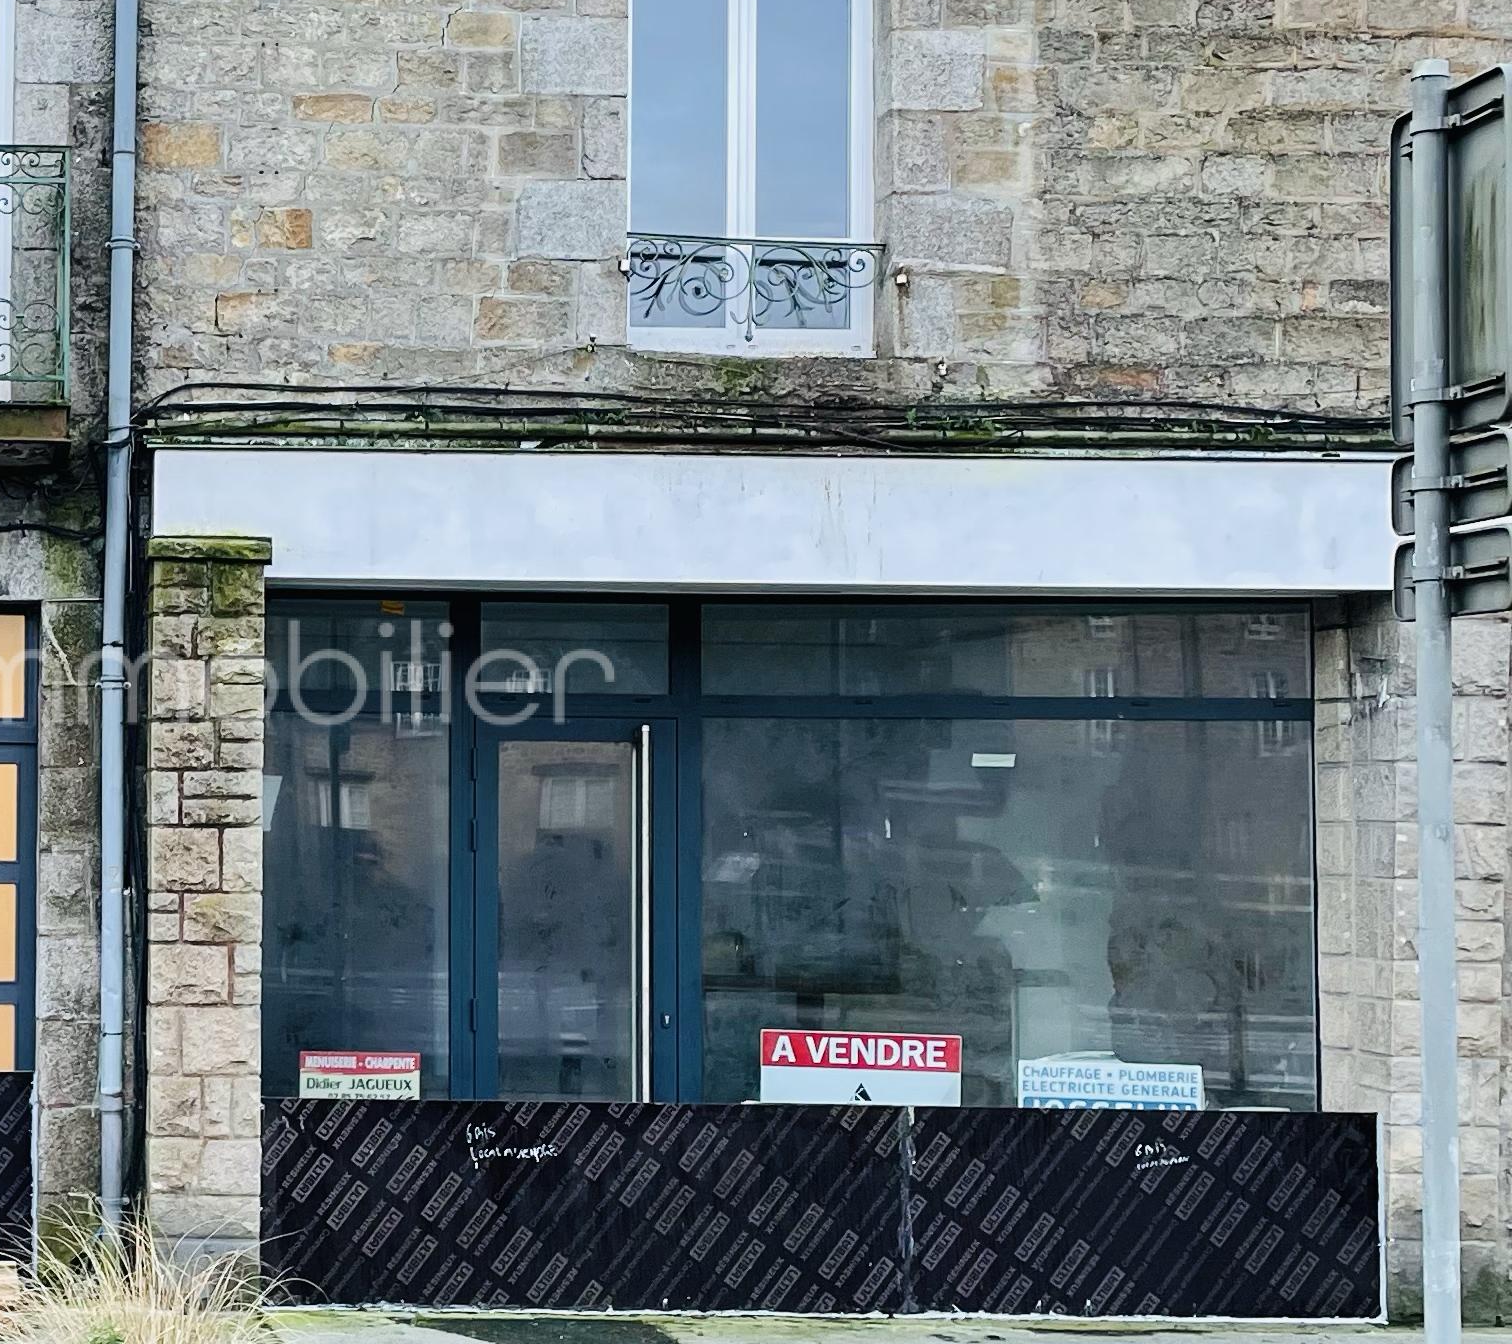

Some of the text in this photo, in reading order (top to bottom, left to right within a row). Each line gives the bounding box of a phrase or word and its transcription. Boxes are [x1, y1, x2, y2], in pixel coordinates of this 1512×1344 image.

[305, 1056, 416, 1070] MENUISERIE CHARPENTE
[771, 1034, 947, 1069] A VENDRE
[1023, 1065, 1198, 1084] CHAUFFAGE PLOMBERIE
[306, 1078, 342, 1089] Didier
[1022, 1081, 1198, 1098] ELECTRICITE GENERALE
[351, 1118, 392, 1168] ULTIBAT
[292, 1153, 333, 1203] ULTIBAT
[386, 1145, 427, 1195] ULTIBAT
[327, 1180, 368, 1230] ULTIBAT
[421, 1172, 462, 1222] ULTIBAT
[362, 1207, 403, 1257] ULTIBAT
[456, 1199, 497, 1249] ULTIBAT
[397, 1234, 438, 1284] ULTIBAT
[491, 1226, 532, 1276] ULTIBAT
[526, 1253, 567, 1303] ULTIBAT
